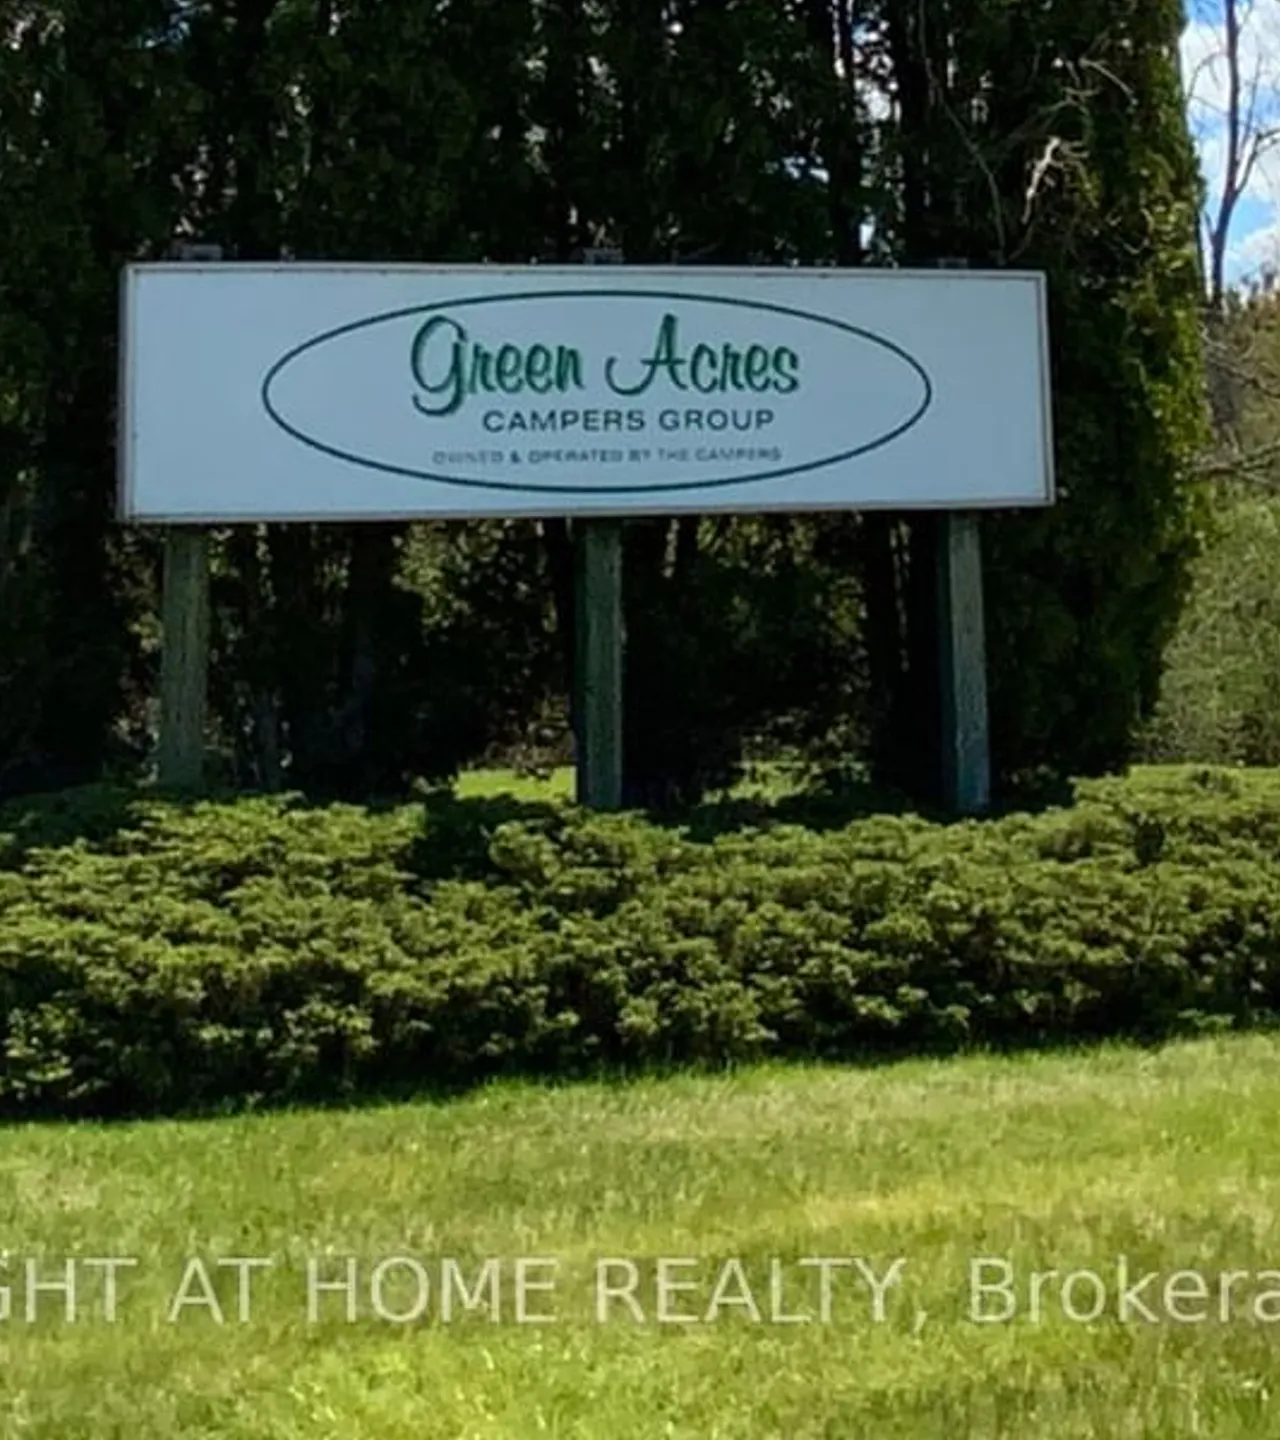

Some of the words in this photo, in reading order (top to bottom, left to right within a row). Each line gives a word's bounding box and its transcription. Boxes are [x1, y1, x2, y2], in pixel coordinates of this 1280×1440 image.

[410, 315, 586, 417] Green
[604, 313, 799, 396] Acres
[483, 409, 645, 433] CAMPERS
[658, 409, 775, 431] GROUP
[432, 450, 504, 464] OWNED
[509, 450, 521, 463] &
[528, 449, 623, 464] OPERATED
[629, 449, 651, 462] BY
[658, 448, 688, 462] THE
[695, 447, 782, 462] CAMPERS
